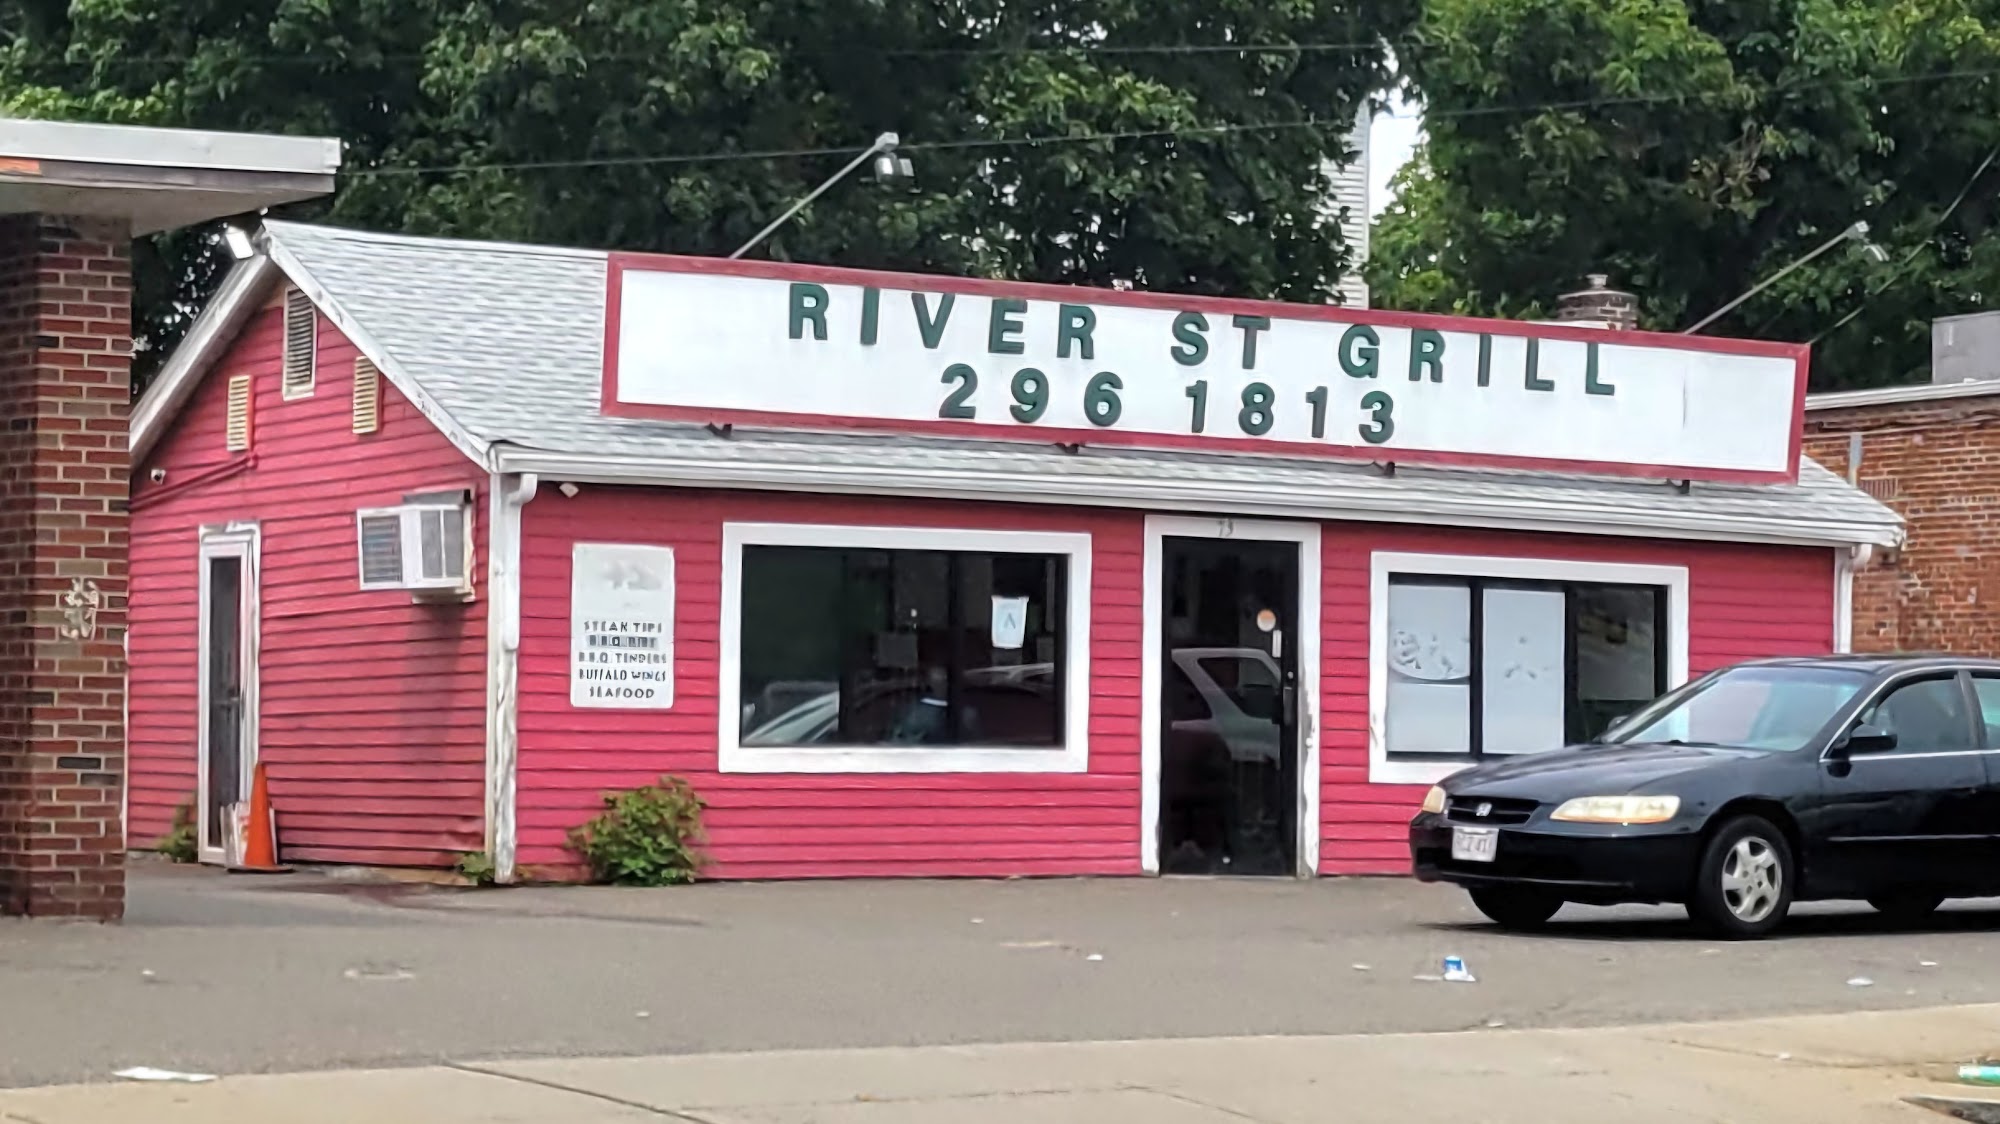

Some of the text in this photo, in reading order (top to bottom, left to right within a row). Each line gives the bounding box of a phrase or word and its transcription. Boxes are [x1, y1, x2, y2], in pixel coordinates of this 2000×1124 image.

[789, 283, 1615, 396] RIVER ST GRILL
[939, 363, 1394, 444] 296 1813
[583, 621, 628, 633] STEAK
[579, 668, 628, 681] BUFFALO
[589, 686, 655, 699] SEAFOOD
